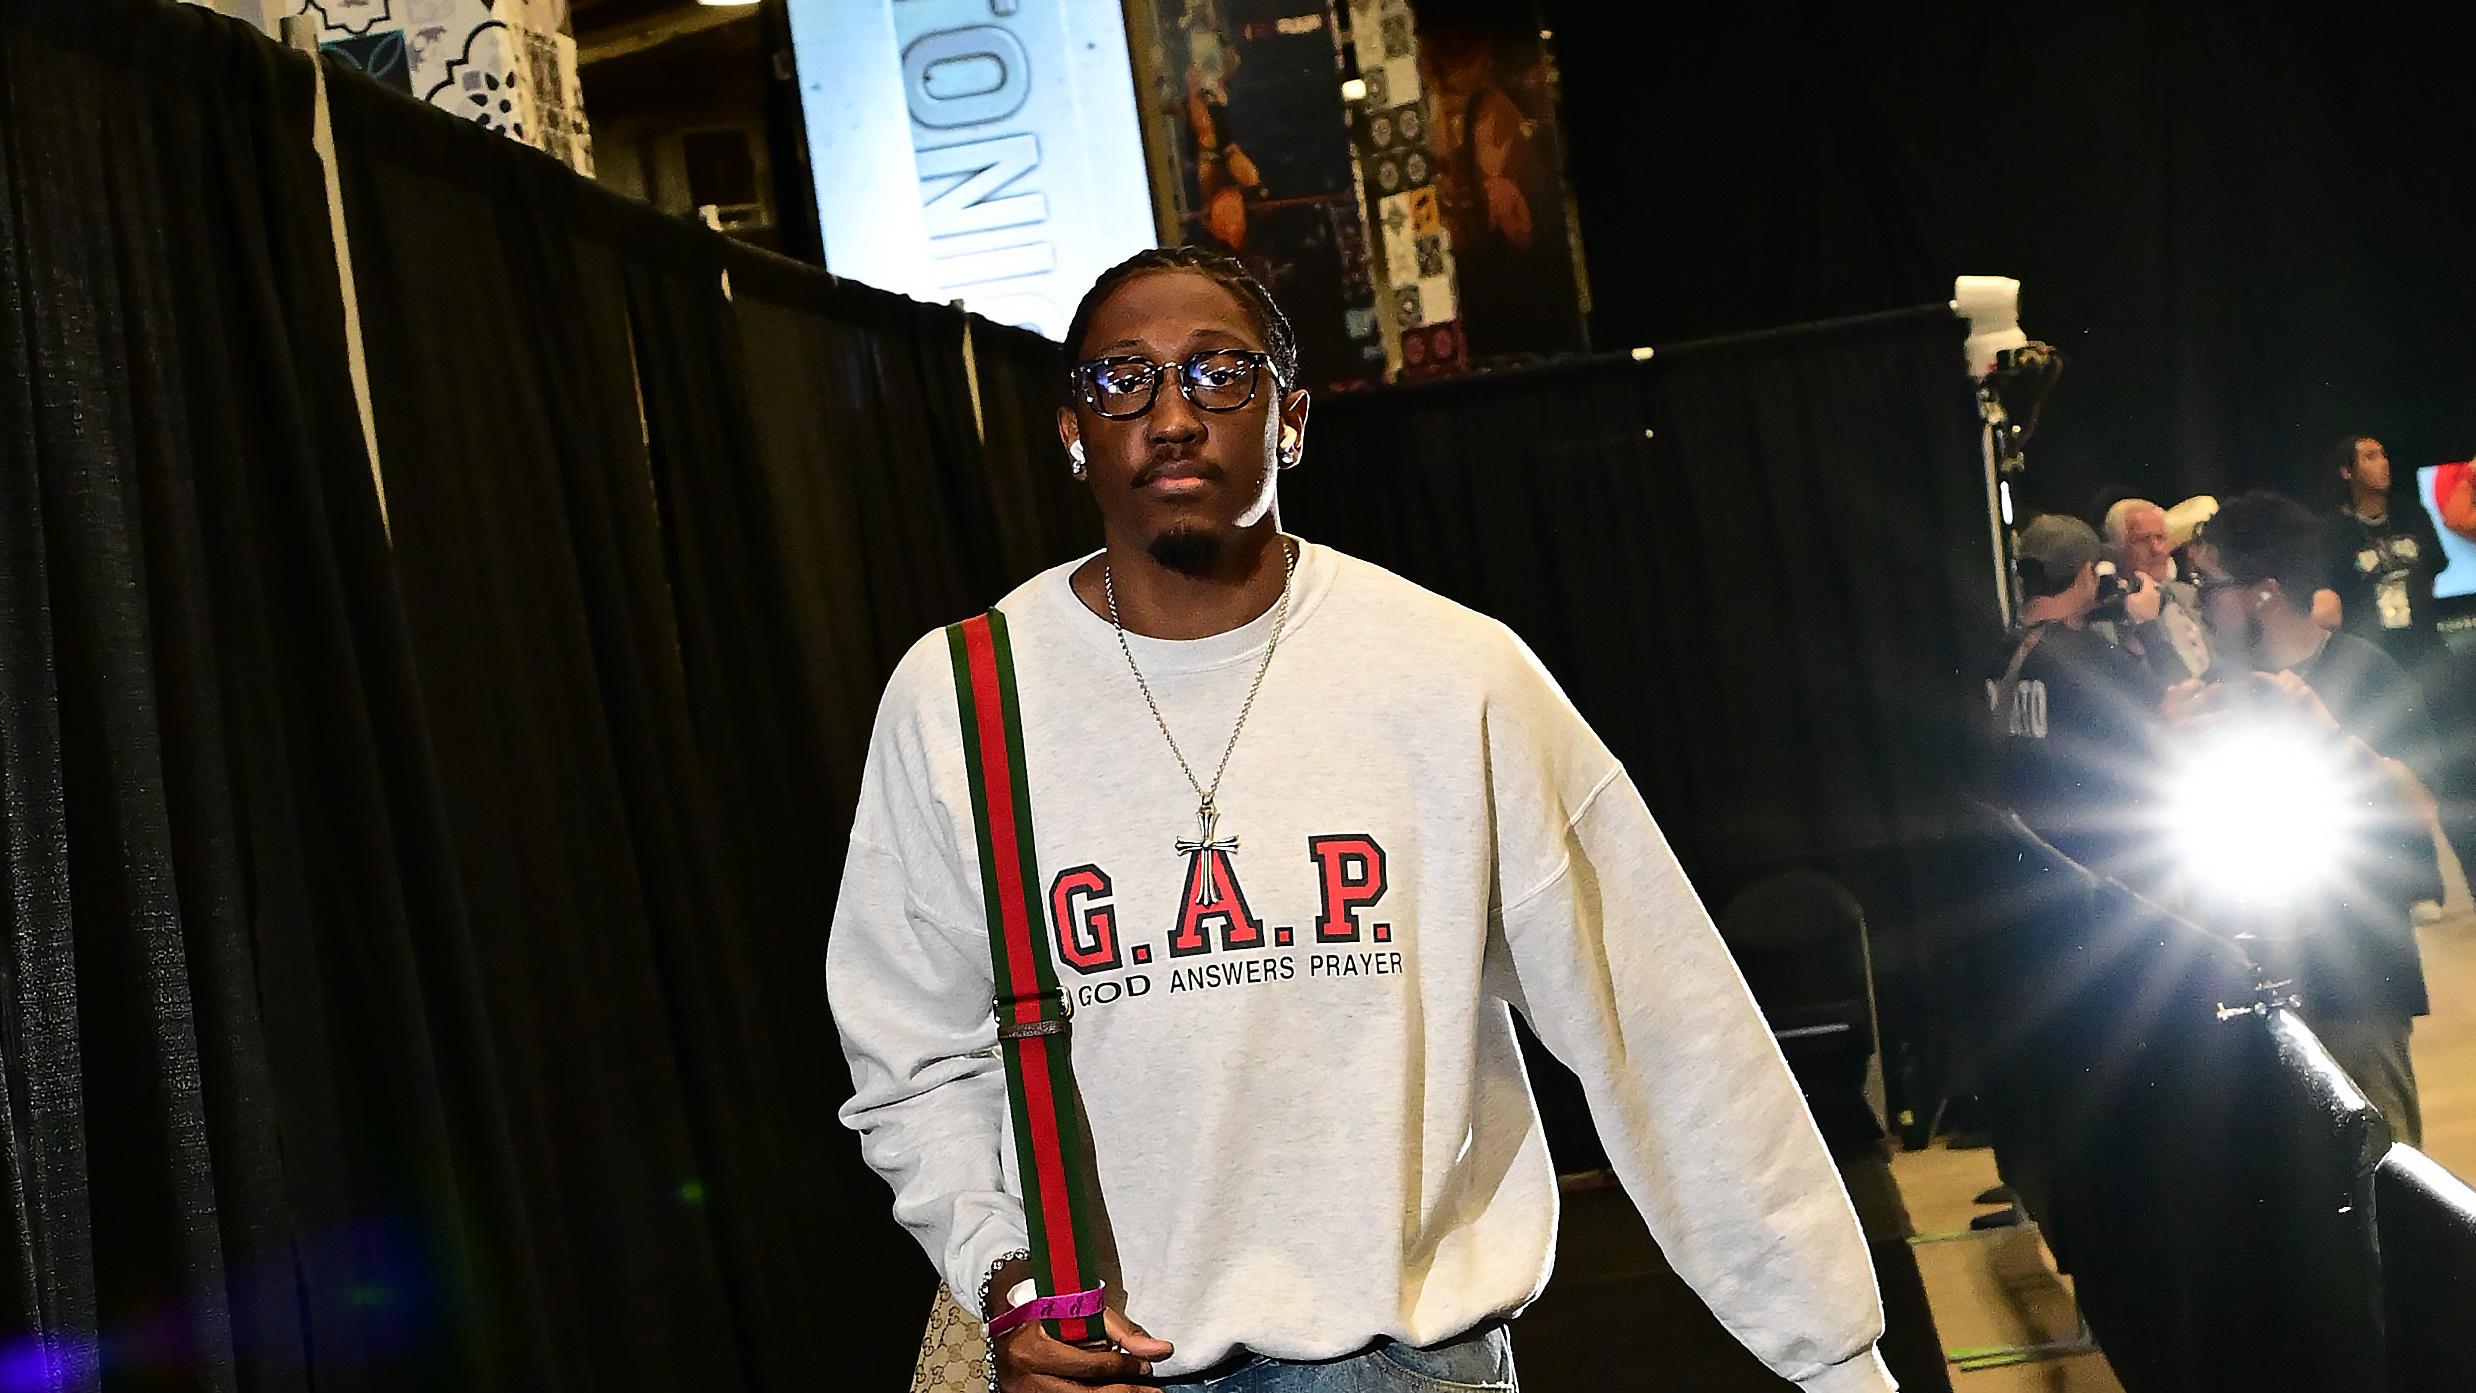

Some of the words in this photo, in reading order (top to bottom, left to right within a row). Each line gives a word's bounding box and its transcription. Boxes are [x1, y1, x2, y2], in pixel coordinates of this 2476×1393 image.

[1048, 833, 1392, 976] G.A.P.
[1078, 974, 1151, 1007] GOD
[1170, 956, 1295, 994] ANSWERS
[1310, 952, 1403, 977] PRAYER
